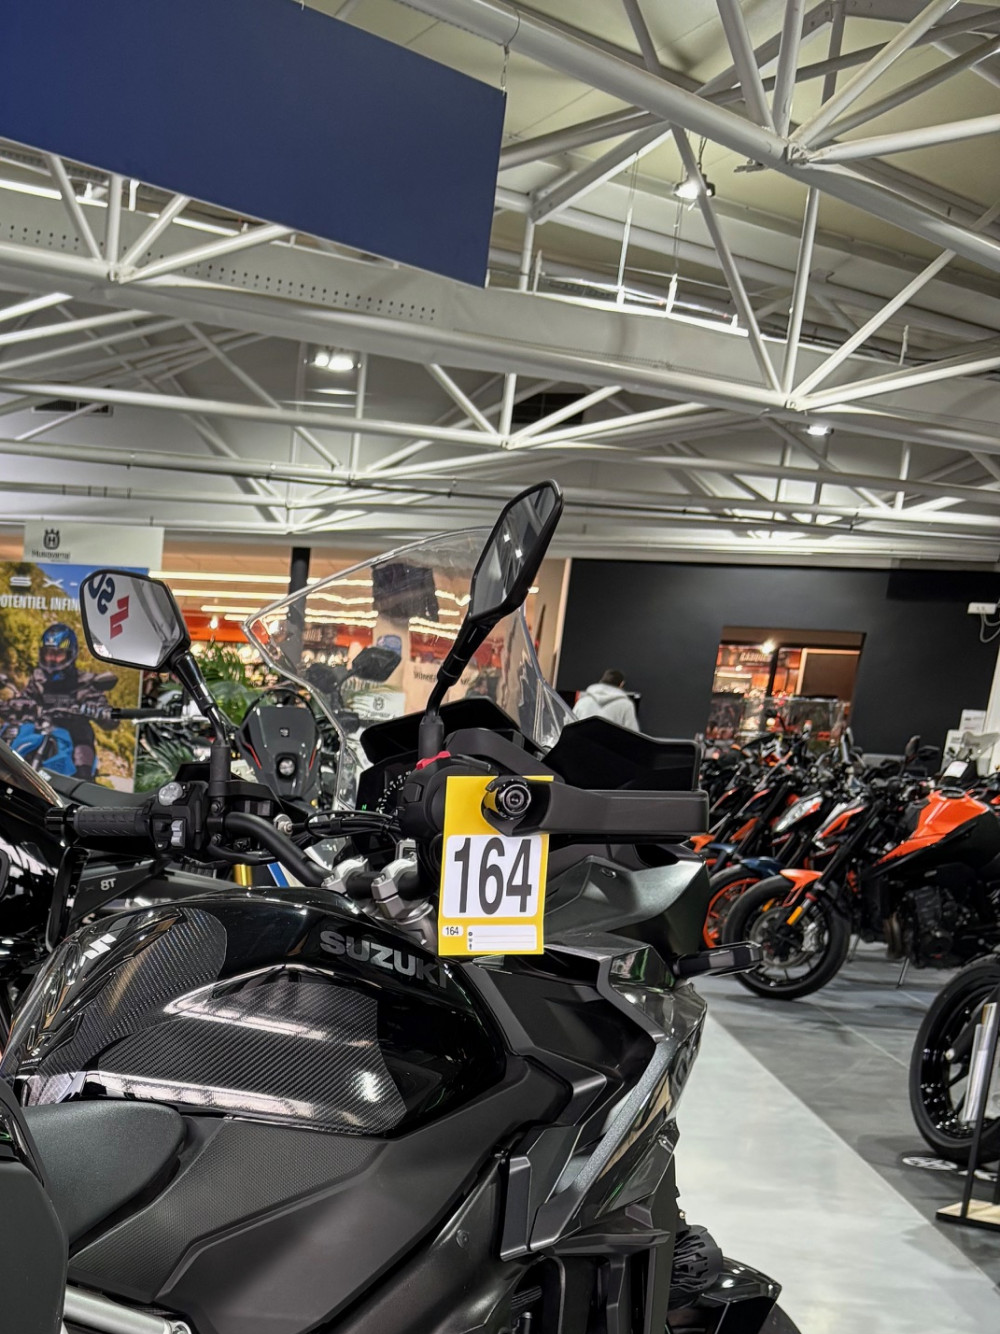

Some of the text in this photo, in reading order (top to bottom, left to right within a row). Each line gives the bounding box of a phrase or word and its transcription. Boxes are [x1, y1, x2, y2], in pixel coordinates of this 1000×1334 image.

[454, 837, 532, 915] 164
[320, 930, 447, 989] SUZUKI
[445, 926, 459, 936] 164
